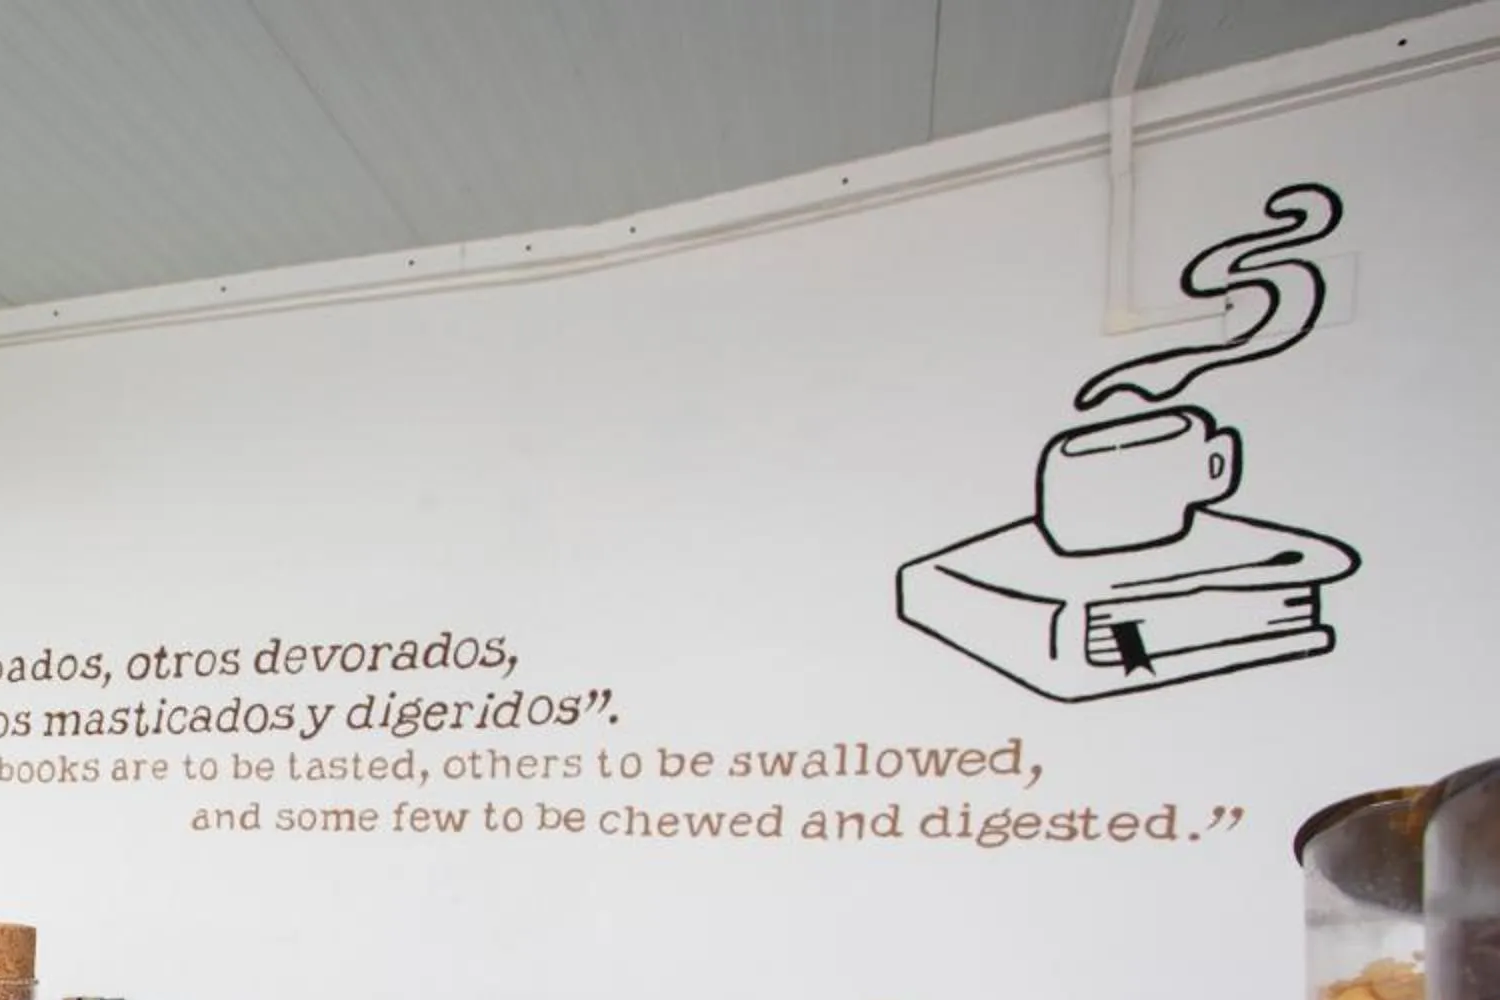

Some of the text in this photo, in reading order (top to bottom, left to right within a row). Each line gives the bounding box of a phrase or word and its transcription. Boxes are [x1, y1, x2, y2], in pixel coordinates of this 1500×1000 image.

[126, 643, 242, 682] otros
[253, 630, 520, 681] devorados,
[41, 696, 296, 739] masticados
[298, 703, 338, 742] y
[110, 757, 170, 783] are
[181, 753, 220, 782] to
[230, 752, 277, 782] be
[287, 748, 431, 789] tasted,
[442, 748, 583, 781] others
[596, 747, 644, 780] to
[655, 746, 716, 780] be
[727, 736, 1045, 791] swallowed,
[189, 801, 262, 833] and
[274, 807, 381, 833] some
[390, 800, 472, 834] few
[483, 800, 525, 834] to
[534, 801, 588, 834] be
[597, 802, 785, 839] chewed
[799, 802, 905, 843] and
